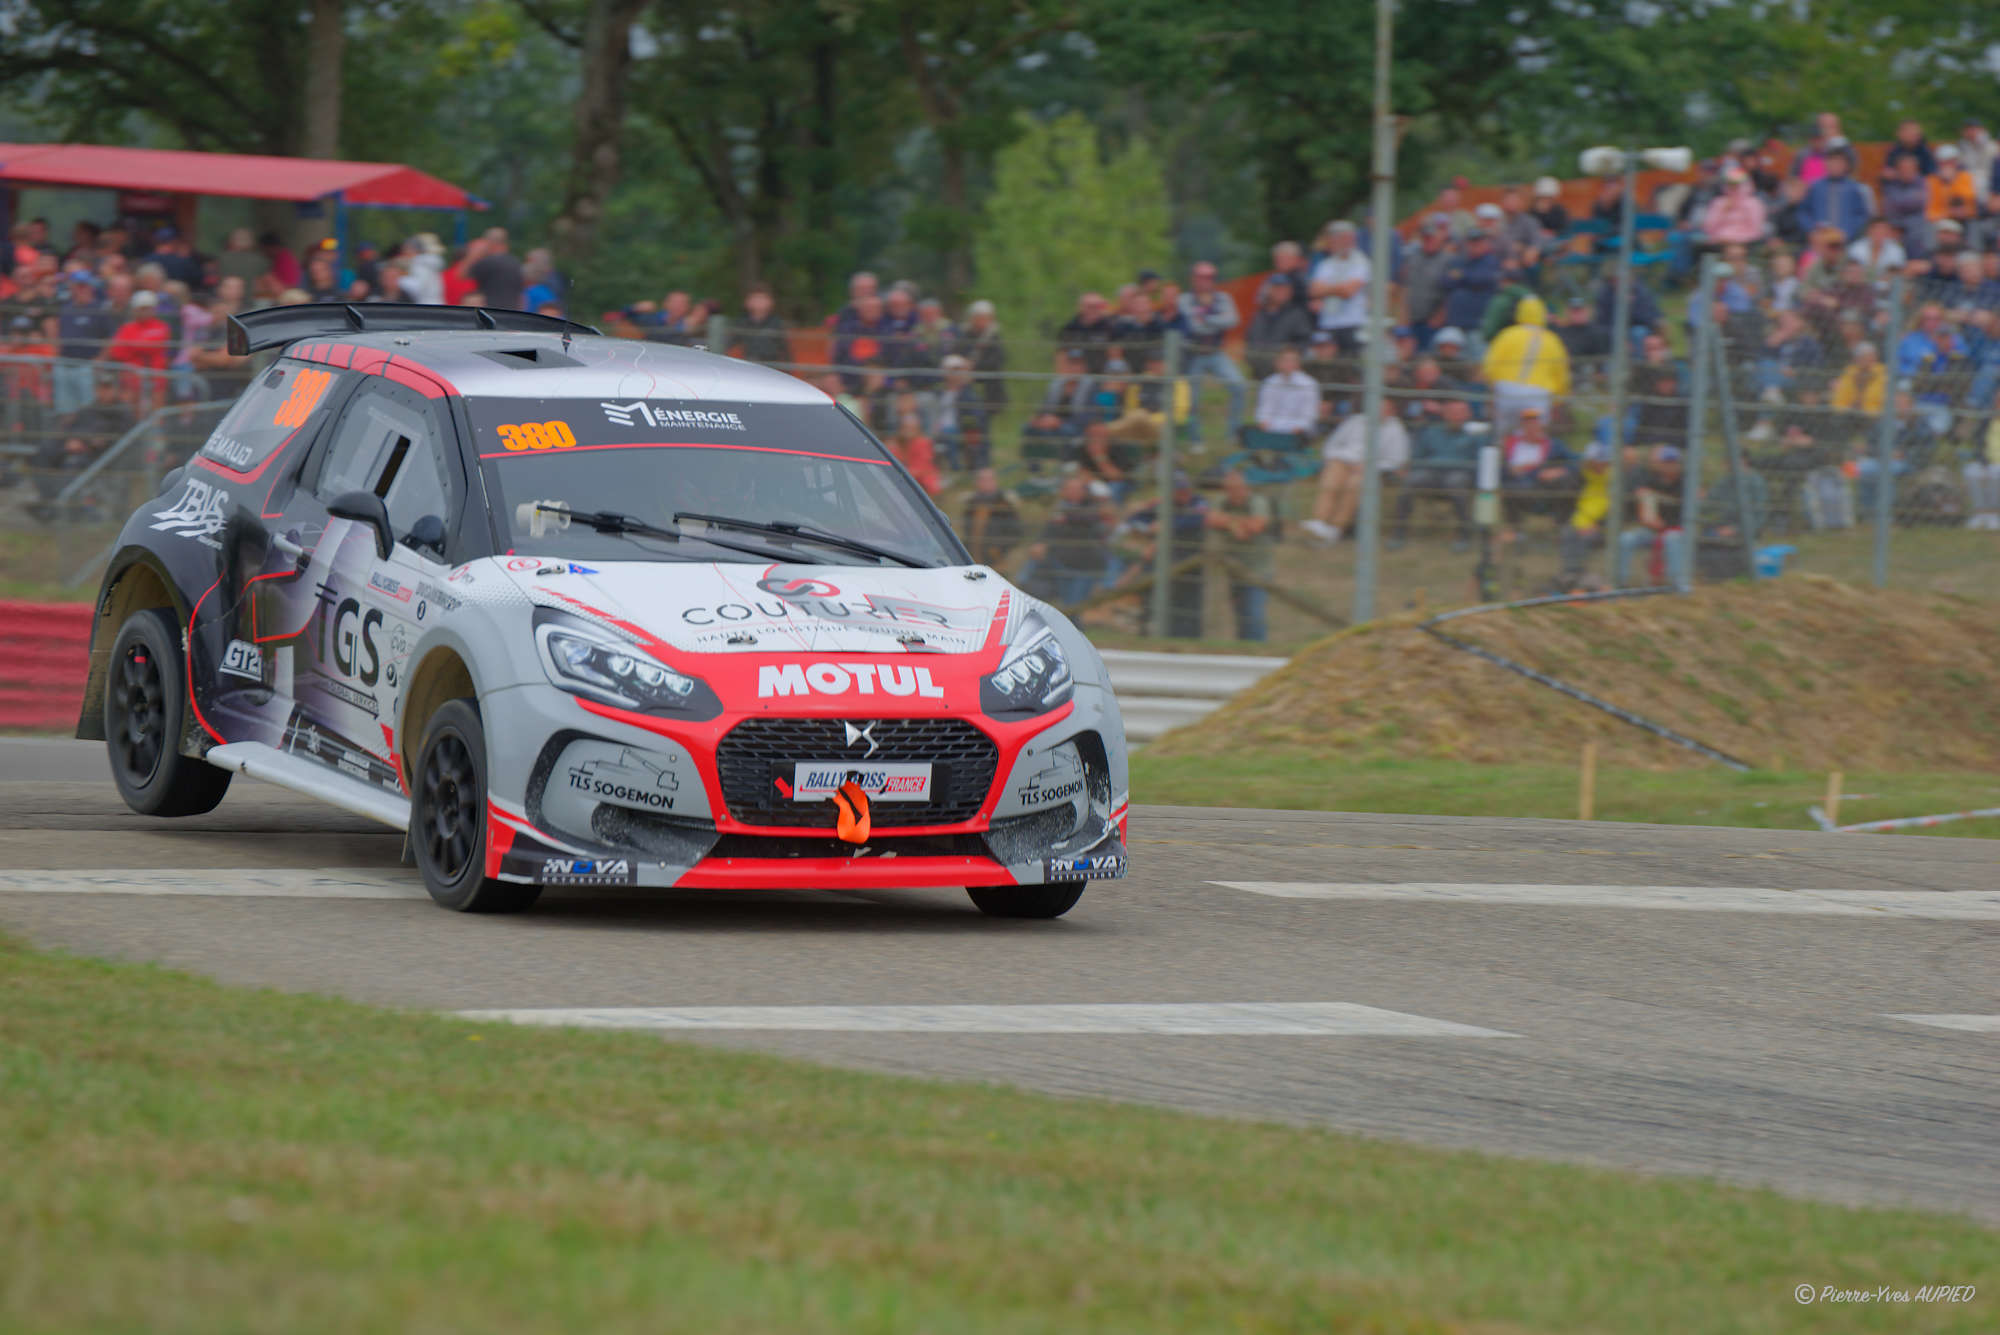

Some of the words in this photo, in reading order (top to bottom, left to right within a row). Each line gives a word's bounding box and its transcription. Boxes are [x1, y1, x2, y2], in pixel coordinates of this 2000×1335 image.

[274, 368, 331, 428] 380
[655, 407, 742, 425] ÉNERGIE
[659, 420, 747, 432] MAINTENANCE
[496, 420, 577, 451] 380
[681, 600, 952, 629] COUTURIER
[758, 662, 945, 698] MOTUL
[569, 774, 591, 790] TLS
[593, 783, 675, 809] SOGEMON
[805, 771, 887, 789] RALLYOSS
[887, 777, 927, 792] FRANCE
[1020, 791, 1040, 806] TLS
[1041, 778, 1084, 801] SOGEMON
[544, 859, 629, 873] NOVA
[1055, 855, 1118, 871] NOVA
